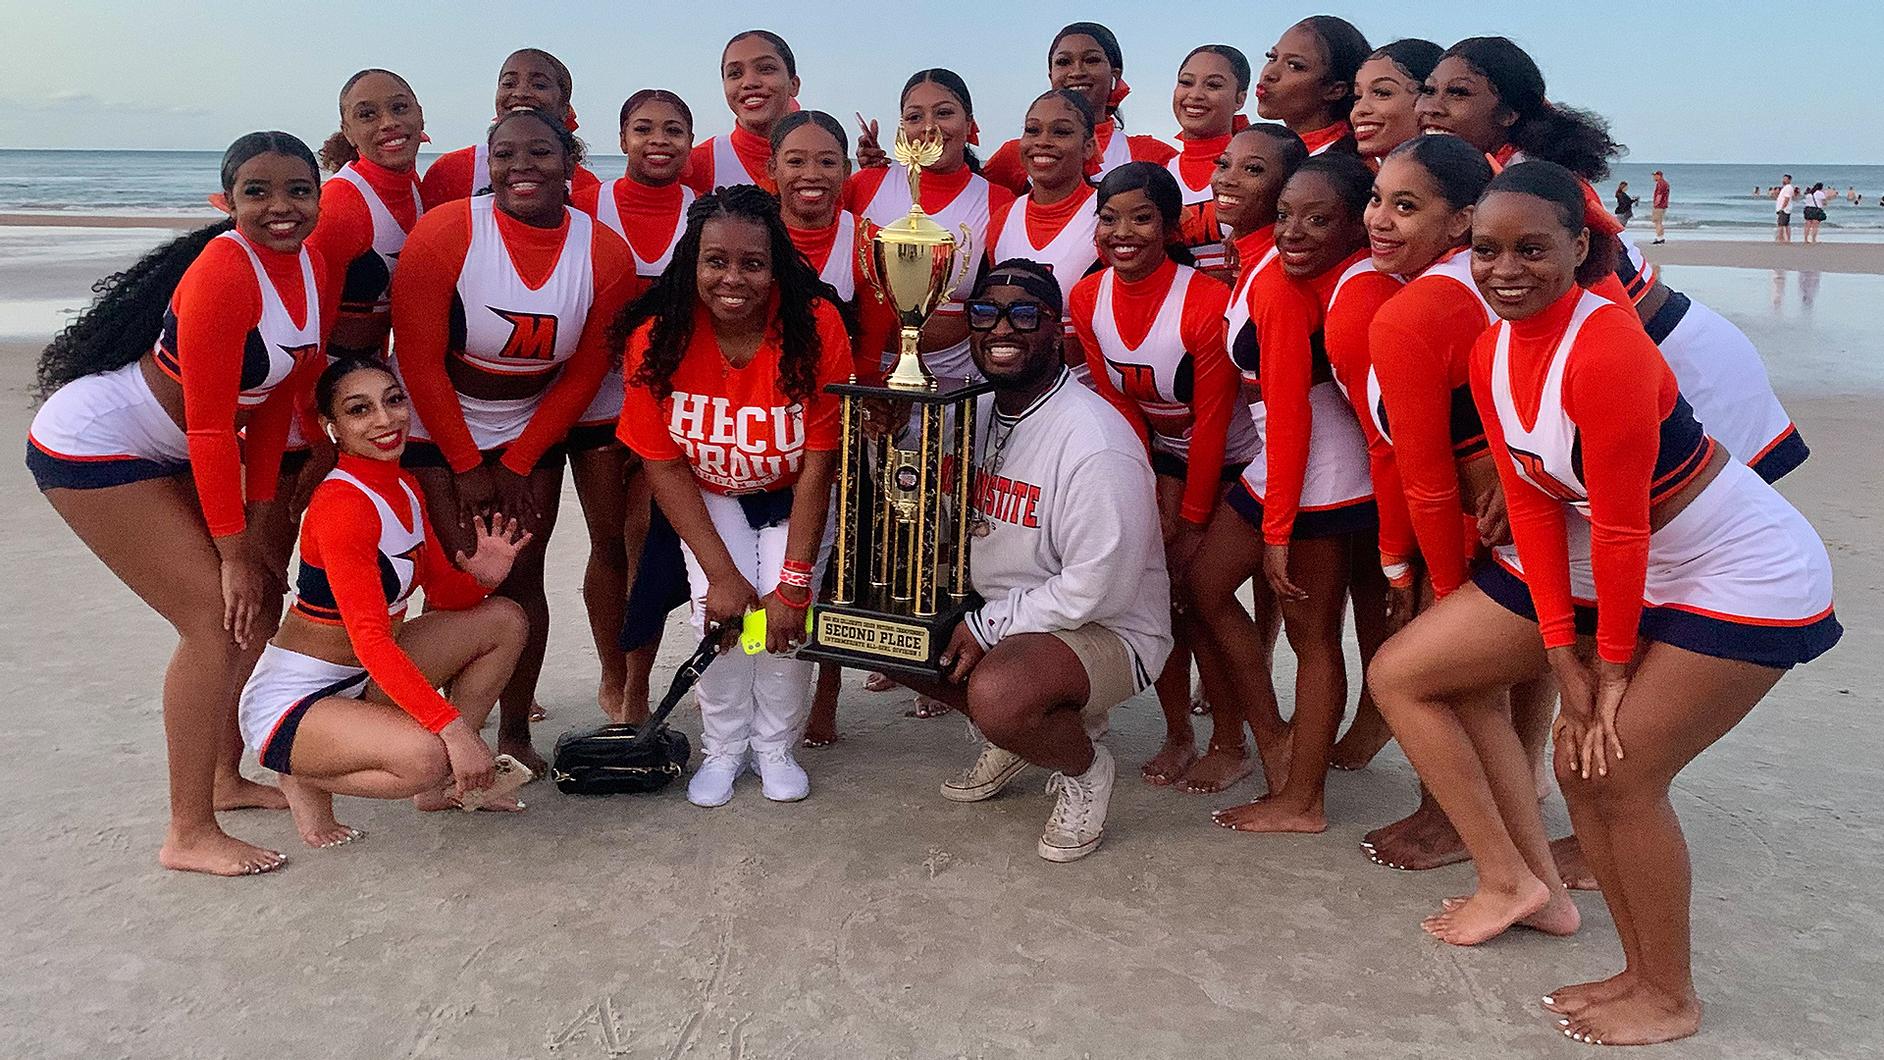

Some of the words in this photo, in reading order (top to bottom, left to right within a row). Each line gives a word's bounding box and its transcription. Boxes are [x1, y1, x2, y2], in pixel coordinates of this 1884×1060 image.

[1182, 200, 1225, 247] M
[484, 304, 559, 361] M
[1103, 356, 1172, 404] M
[825, 623, 875, 642] SECOND
[880, 631, 921, 650] PLACE
